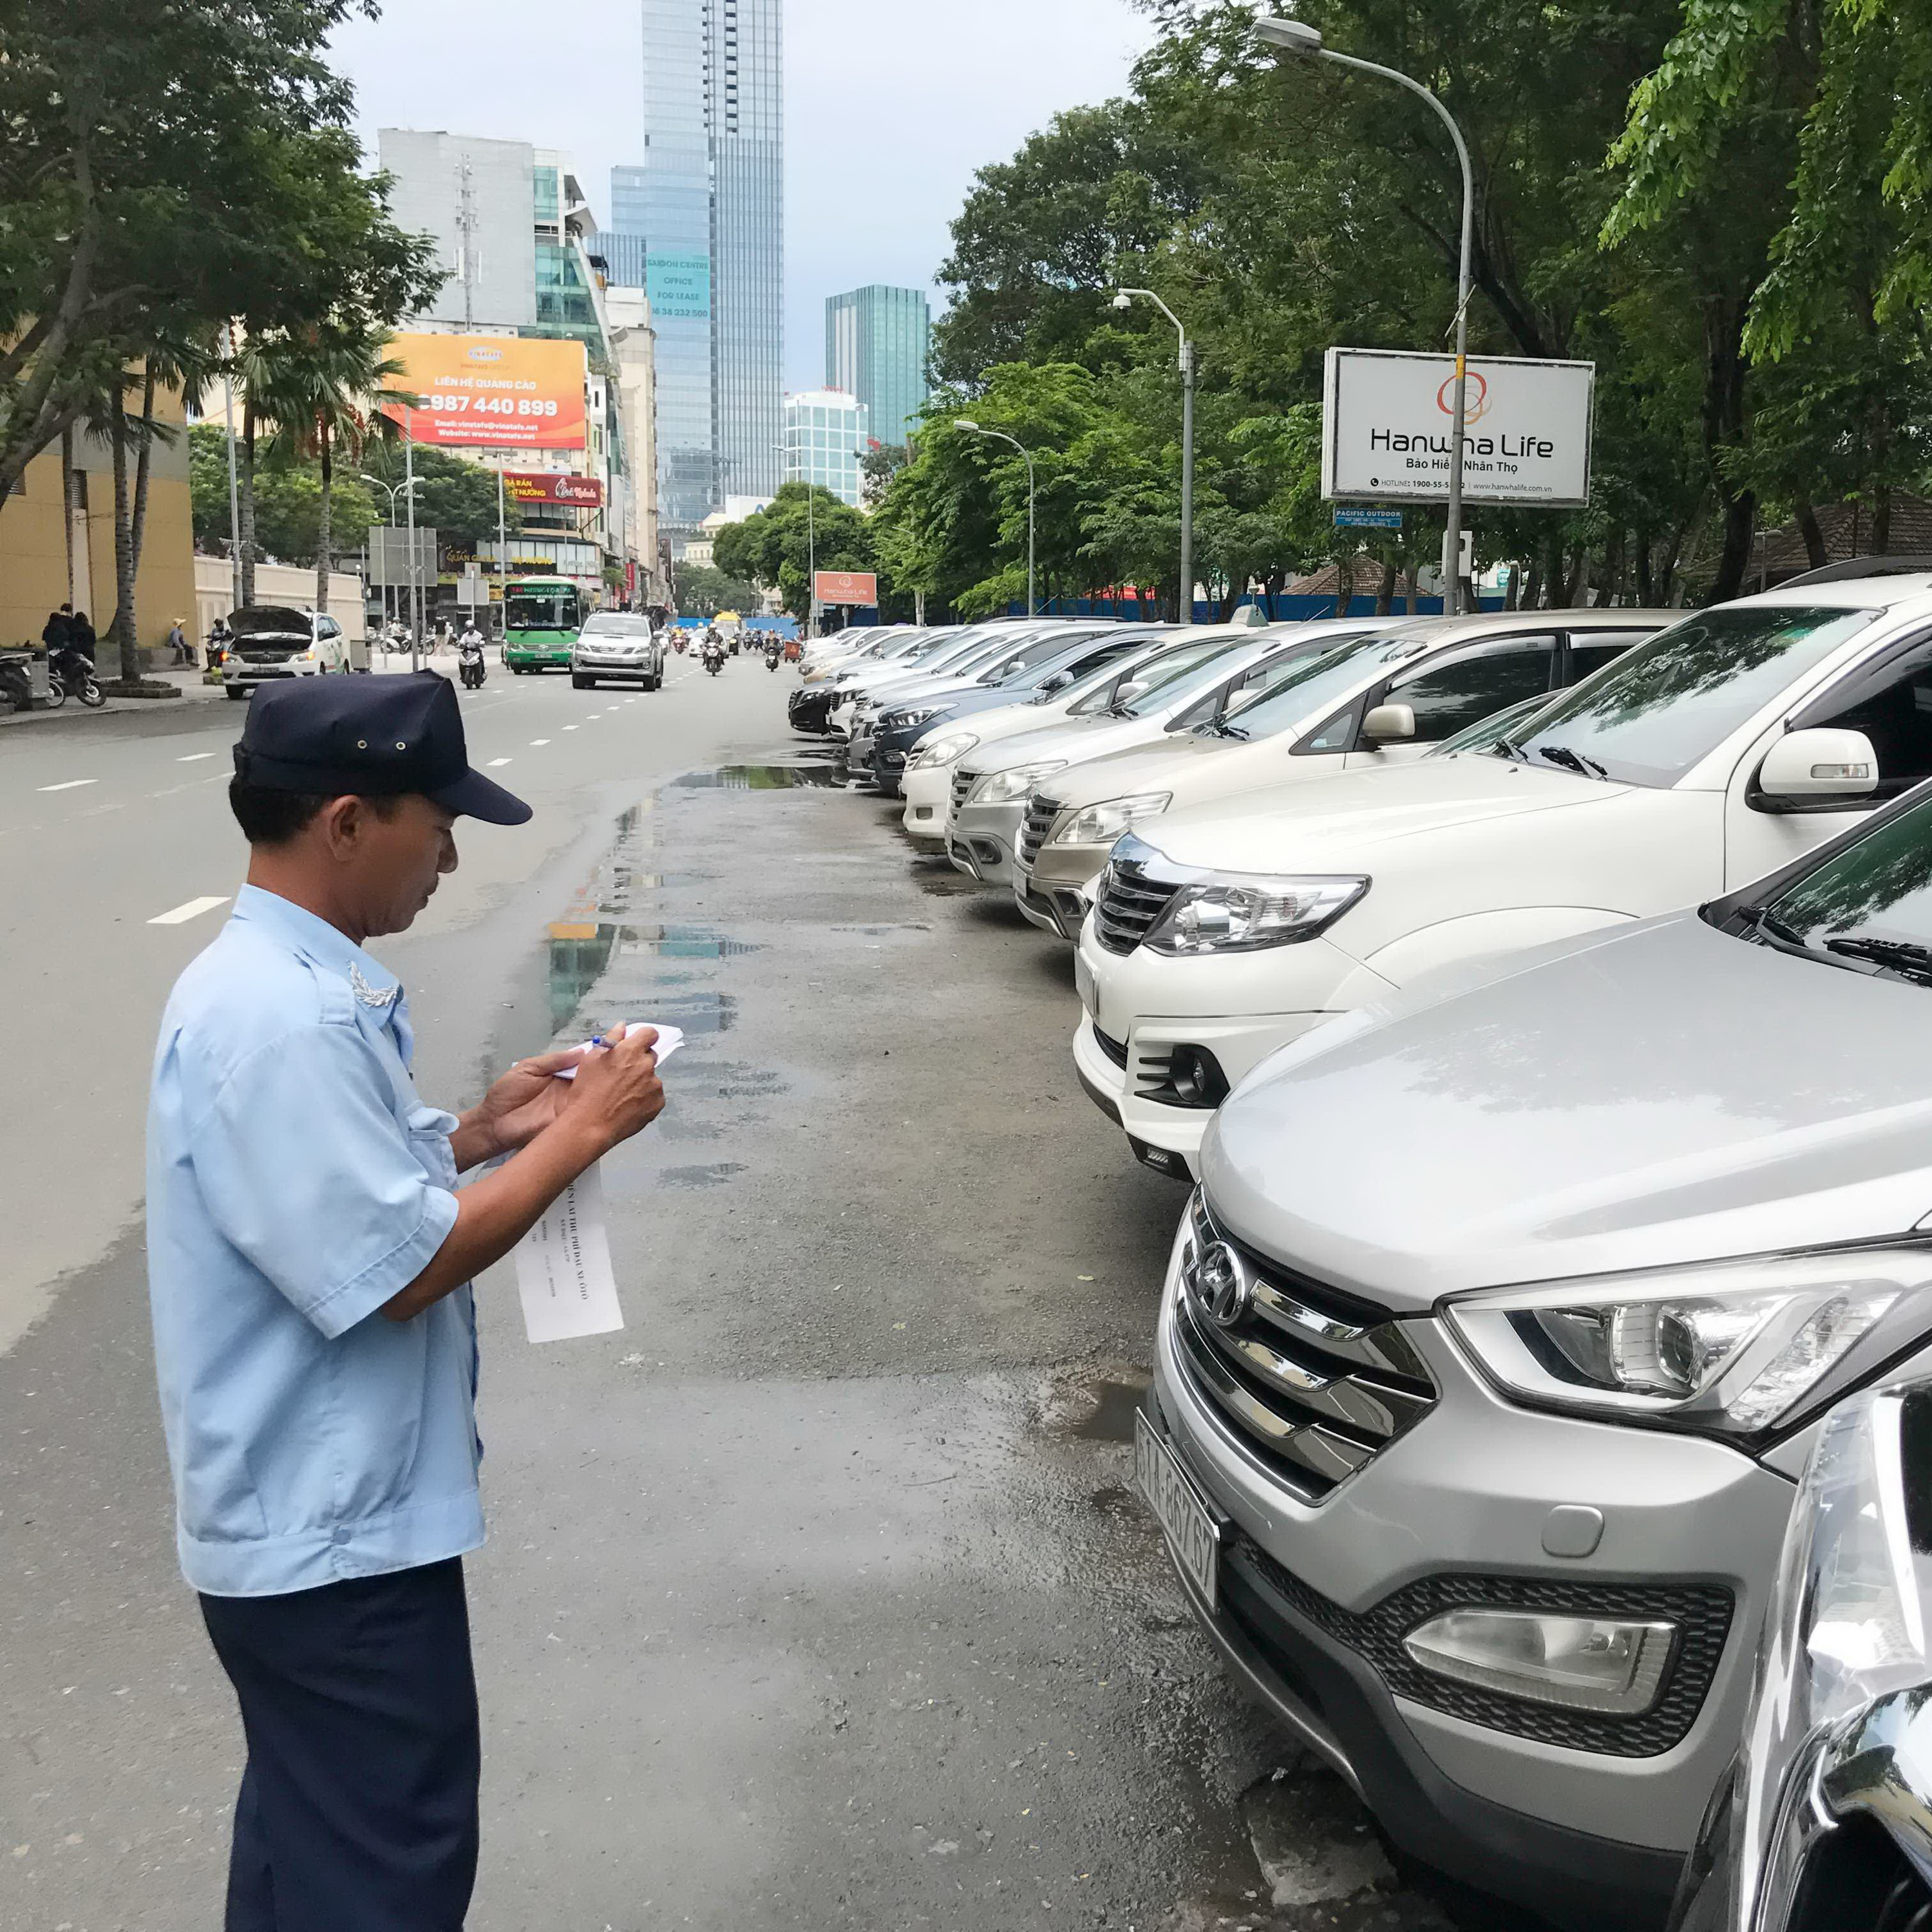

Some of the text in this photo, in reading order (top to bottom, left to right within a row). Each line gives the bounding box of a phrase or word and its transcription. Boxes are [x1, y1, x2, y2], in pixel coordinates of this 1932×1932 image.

[647, 259, 678, 268] SAIGON
[664, 277, 693, 285] OFFICE
[676, 292, 699, 301] LEASE
[435, 375, 458, 386] LIÊN
[460, 377, 475, 390] HỆ
[473, 397, 515, 415] 440
[518, 399, 558, 417] 899
[435, 419, 457, 428] Email:
[438, 429, 471, 438] Website:
[1501, 434, 1554, 458] Life
[1406, 457, 1518, 475] Bảo Hiể Nhân Thọ
[1473, 482, 1553, 493] www.hanwhalife.com.vn
